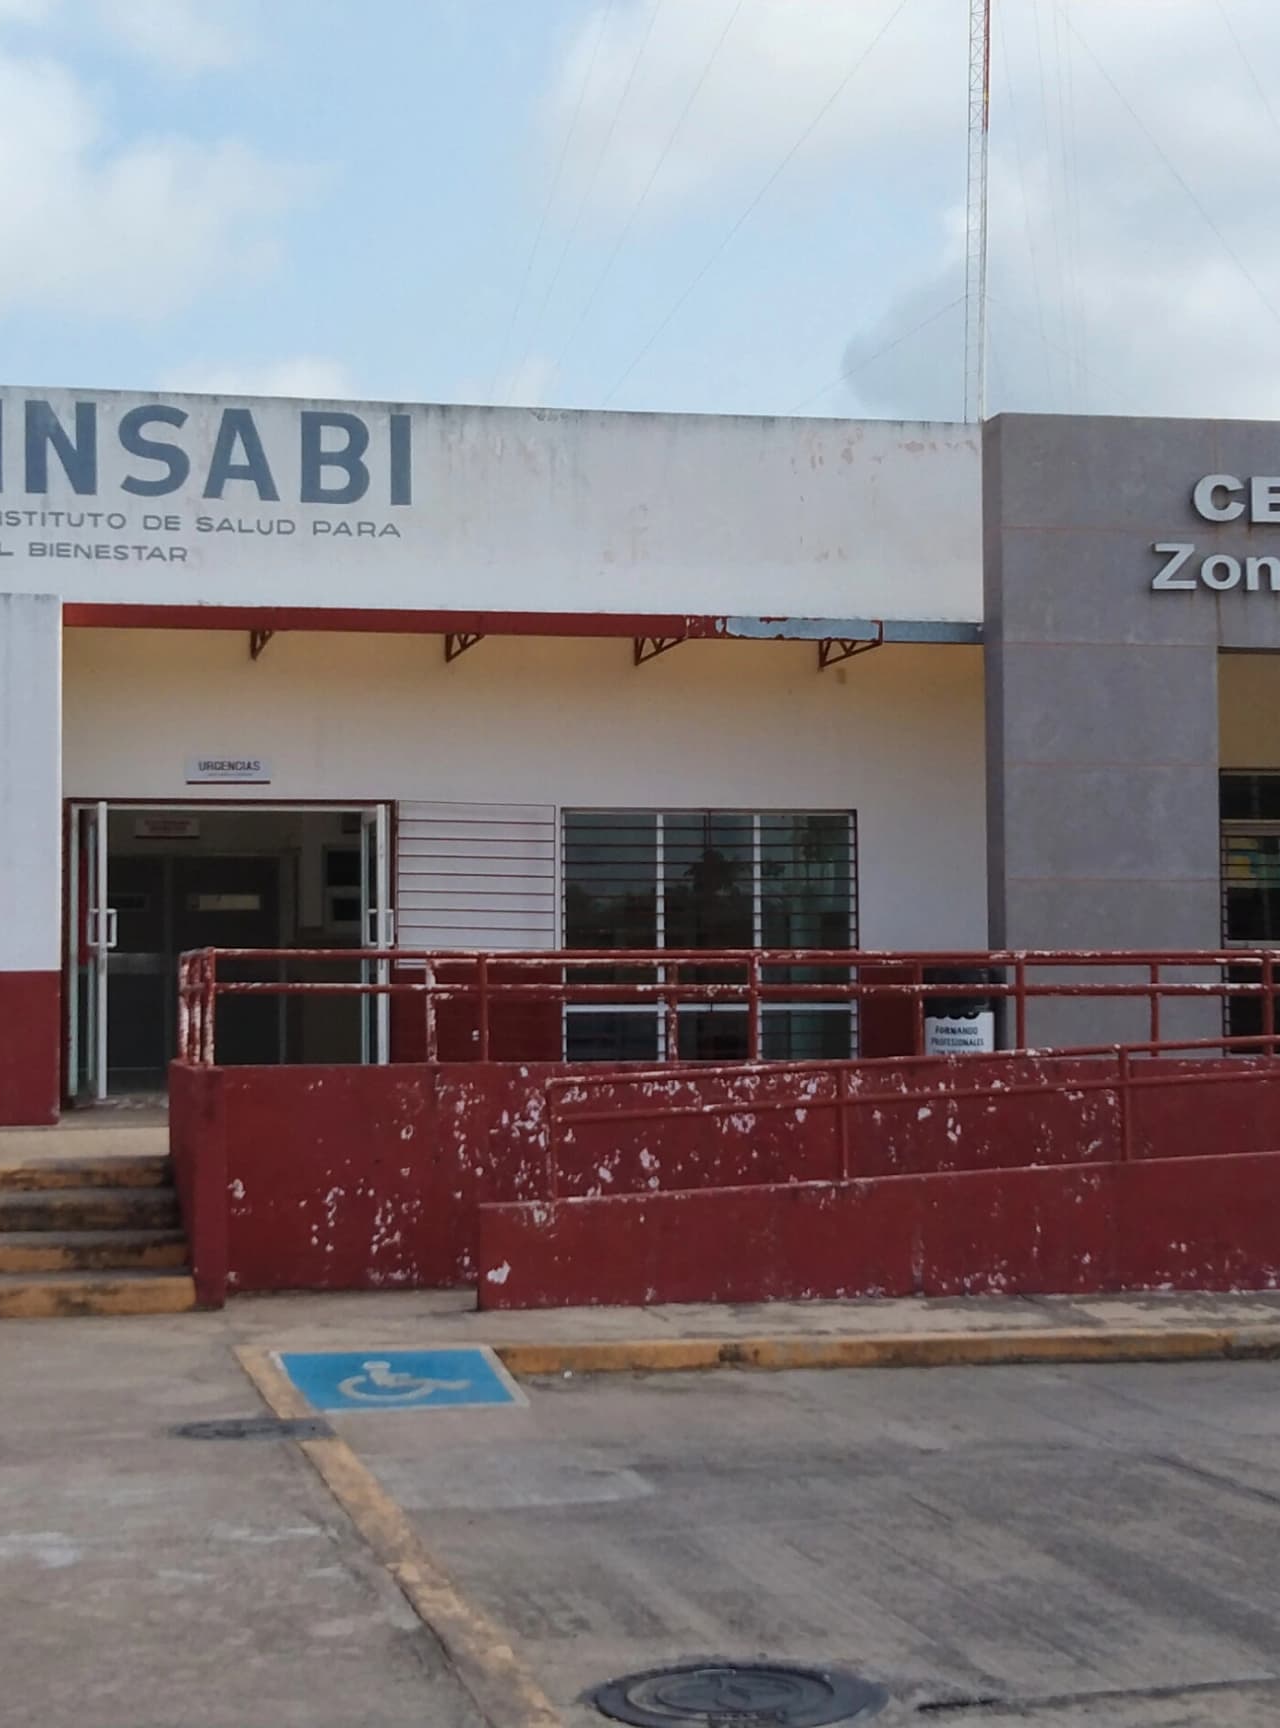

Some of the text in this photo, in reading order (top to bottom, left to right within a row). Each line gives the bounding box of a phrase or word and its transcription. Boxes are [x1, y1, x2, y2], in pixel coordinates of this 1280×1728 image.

[142, 514, 181, 532] DE
[195, 516, 296, 536] SALUD
[312, 520, 402, 539] PARA
[28, 541, 188, 563] BIENESTAR
[198, 760, 261, 772] URGENCIAS
